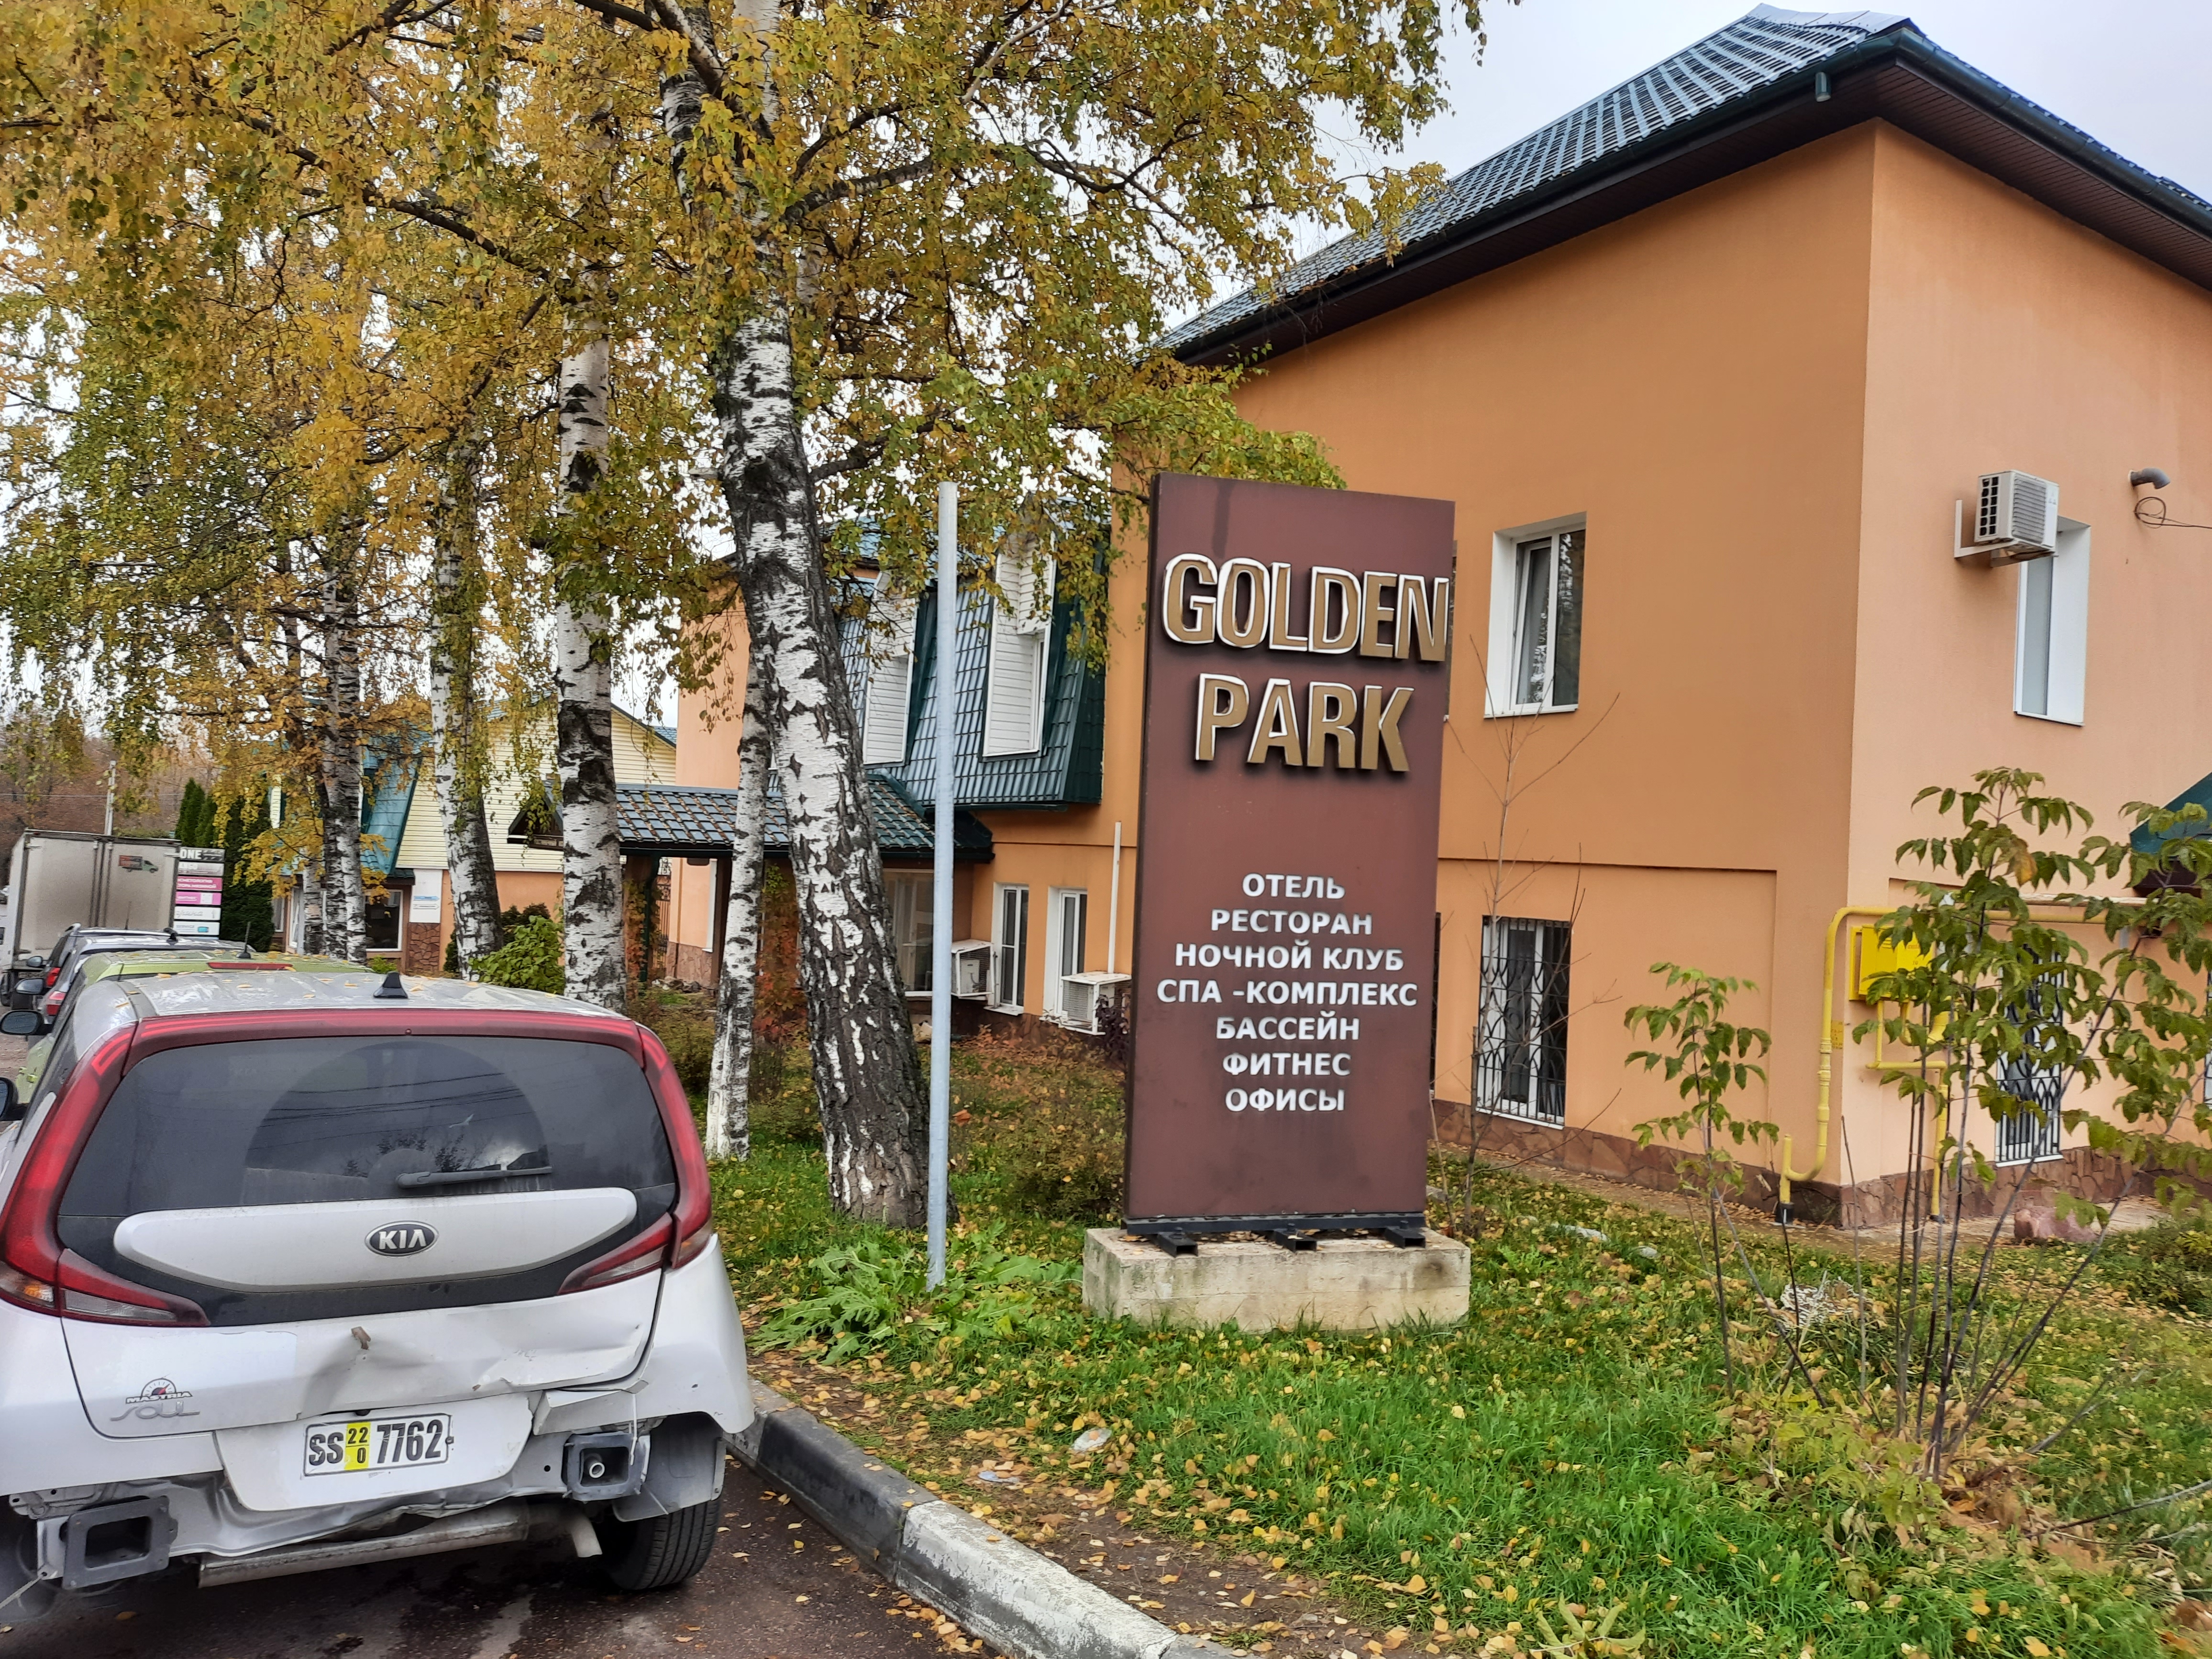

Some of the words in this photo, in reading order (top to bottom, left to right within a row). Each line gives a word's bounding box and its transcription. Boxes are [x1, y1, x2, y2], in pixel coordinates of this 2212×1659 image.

[1162, 553, 1450, 662] GOLDEN
[1195, 673, 1415, 772] PARK
[1242, 873, 1345, 899] ОТЕЛЬ
[1211, 909, 1372, 935] РЕСТОРАН
[1174, 940, 1312, 969] НОЧНОЙ
[1323, 947, 1405, 971] КЛУБ
[1157, 979, 1222, 1003] СПА
[1216, 1010, 1360, 1040] БАССЕЙН
[1222, 1052, 1351, 1076] ФИТНЕС
[1225, 1088, 1345, 1111] ОФИСЫ
[378, 1229, 427, 1250] KIA
[126, 1391, 192, 1404] MASTRIA
[309, 1432, 344, 1466] SS
[377, 1419, 442, 1464] 7762
[348, 1427, 368, 1445] 22
